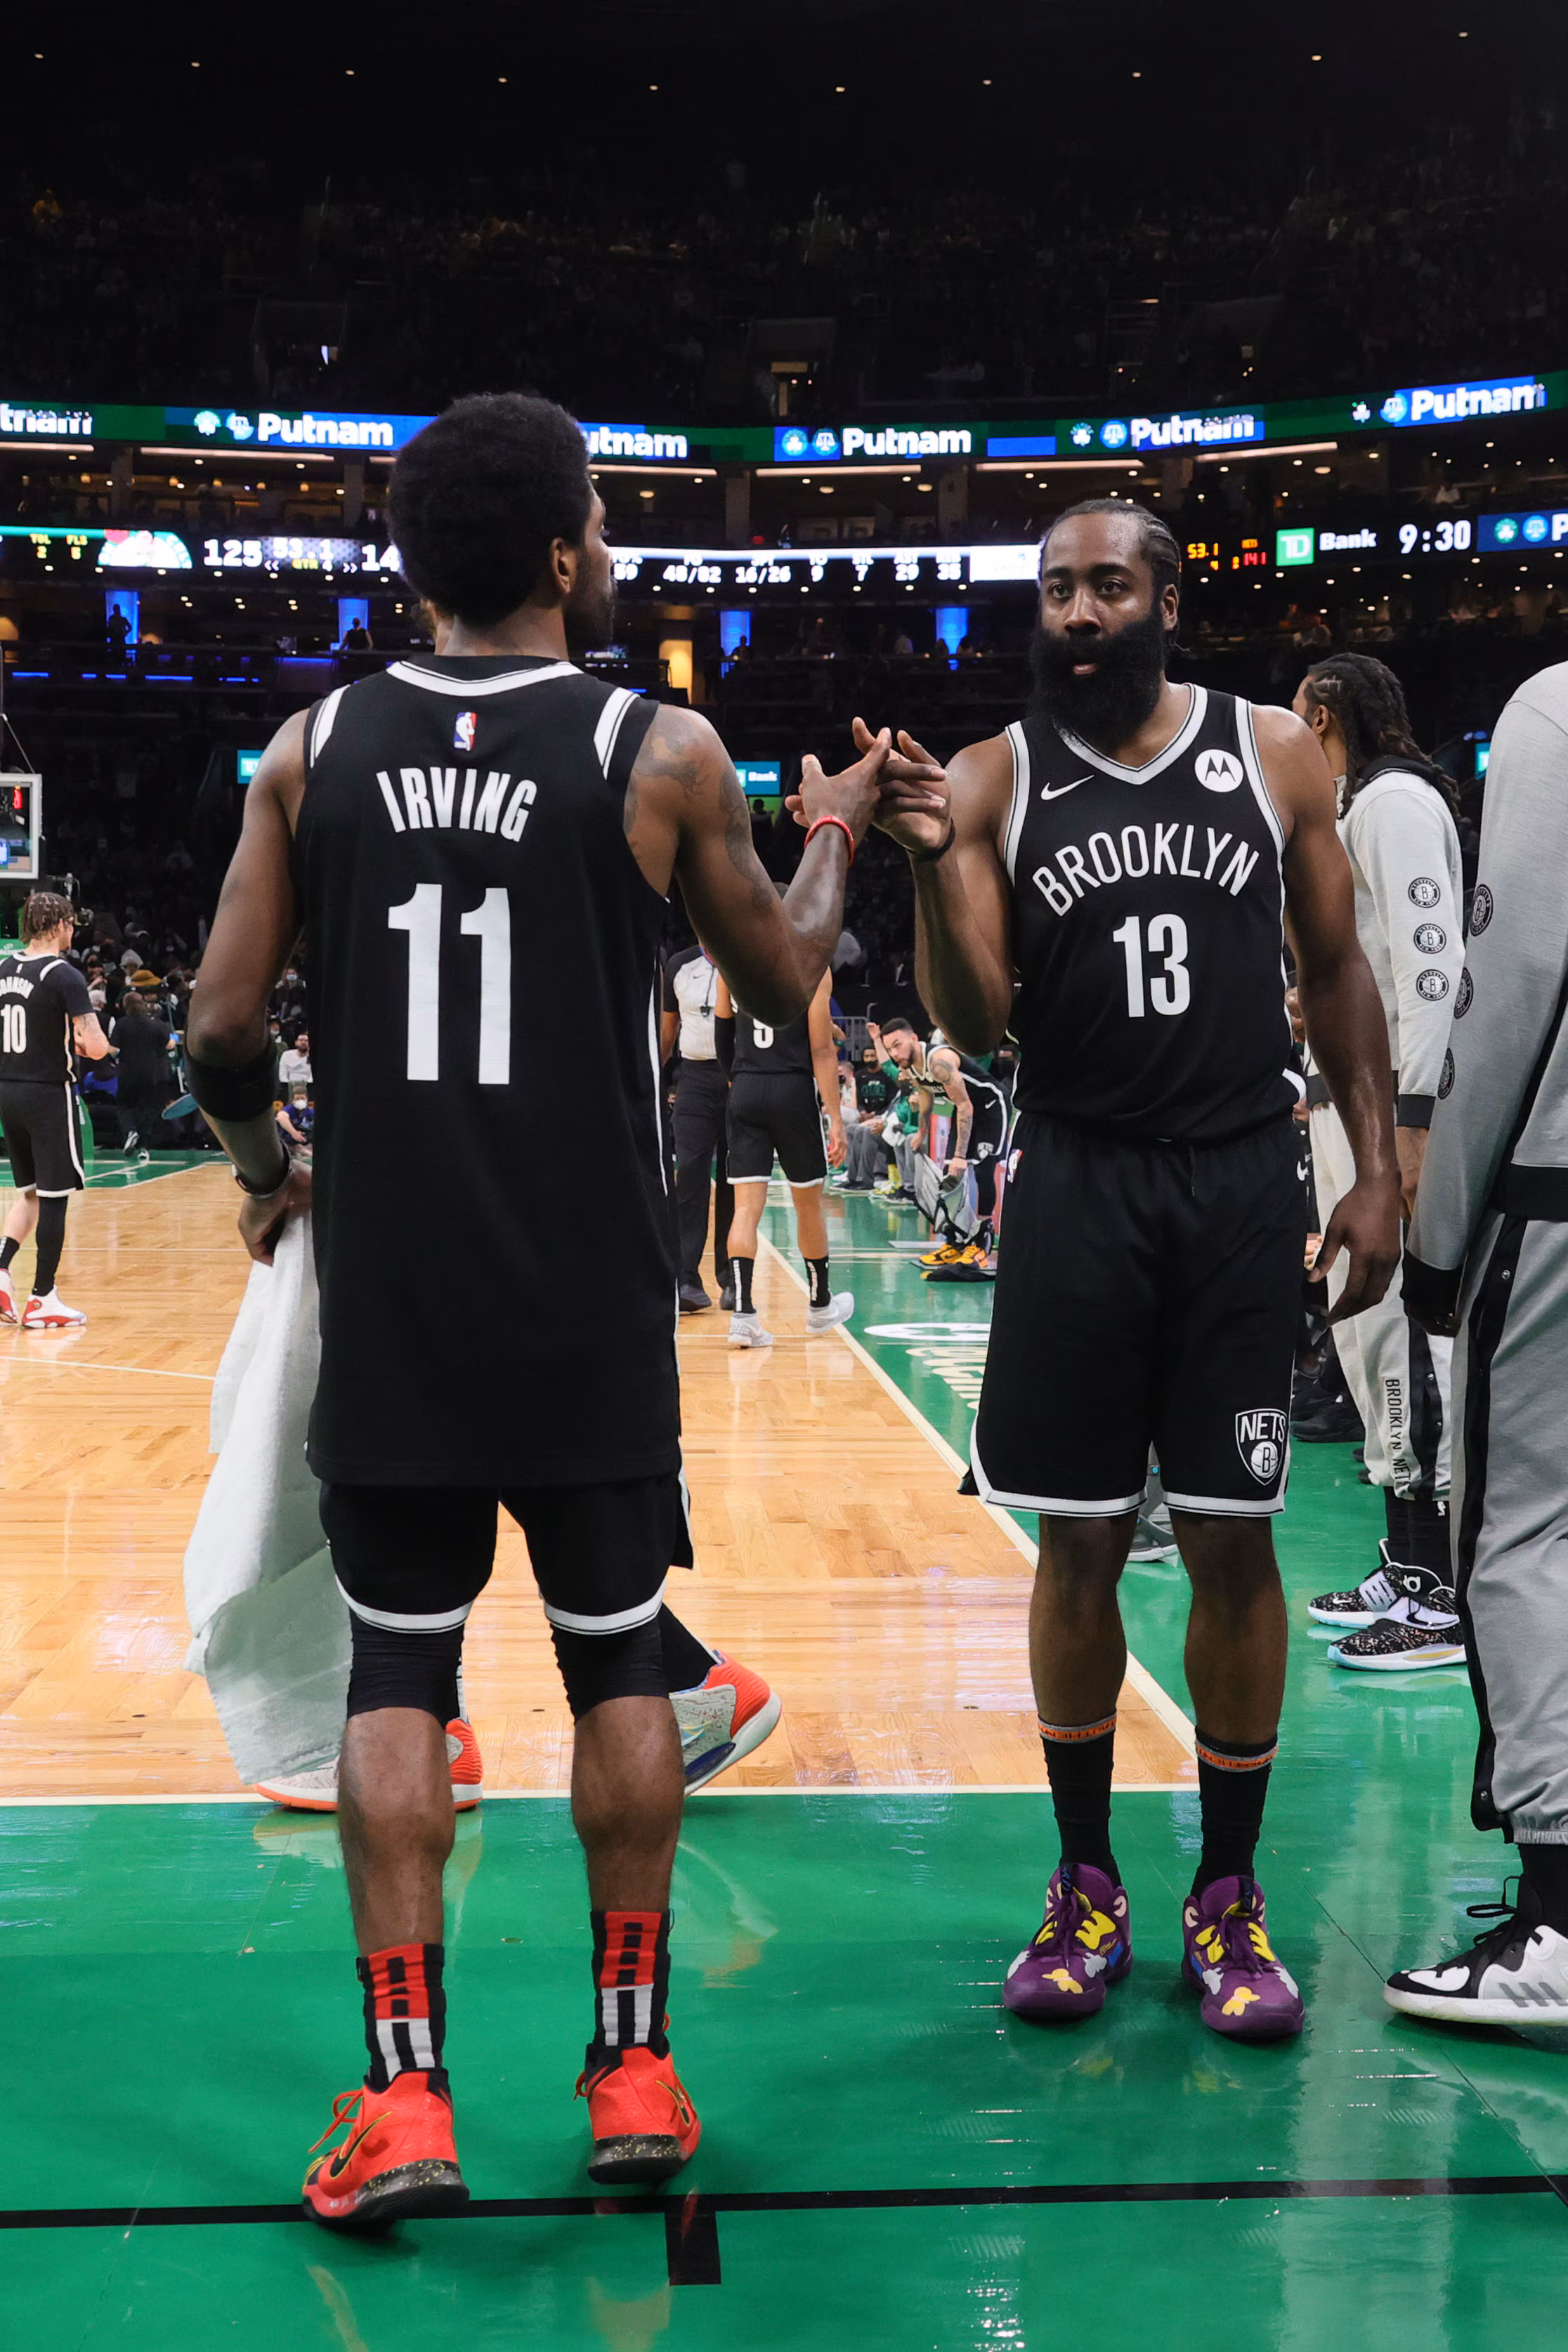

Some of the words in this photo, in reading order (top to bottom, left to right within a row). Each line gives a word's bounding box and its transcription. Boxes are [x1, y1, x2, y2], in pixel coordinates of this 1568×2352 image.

[1411, 386, 1545, 421] Putnam
[257, 412, 393, 446] Putnam
[843, 428, 972, 455] Putnam
[1130, 414, 1255, 447] Putnam
[204, 539, 263, 567] 125
[273, 537, 334, 560] 53.1
[1281, 535, 1310, 558] TD
[1319, 528, 1377, 551] Bank
[1399, 520, 1471, 554] 9:30
[811, 566, 824, 582] 9
[855, 565, 869, 582] 7
[895, 564, 919, 581] 29
[1243, 551, 1267, 566] 141
[735, 566, 791, 584] 16/26
[376, 766, 538, 842] IRVING
[1032, 823, 1259, 916] BROOKLYN
[1113, 913, 1191, 1018] 13
[388, 883, 511, 1085] 11
[0, 1004, 27, 1054] 10
[1240, 1412, 1286, 1444] NETS
[1385, 1378, 1403, 1450] BROOKLYN
